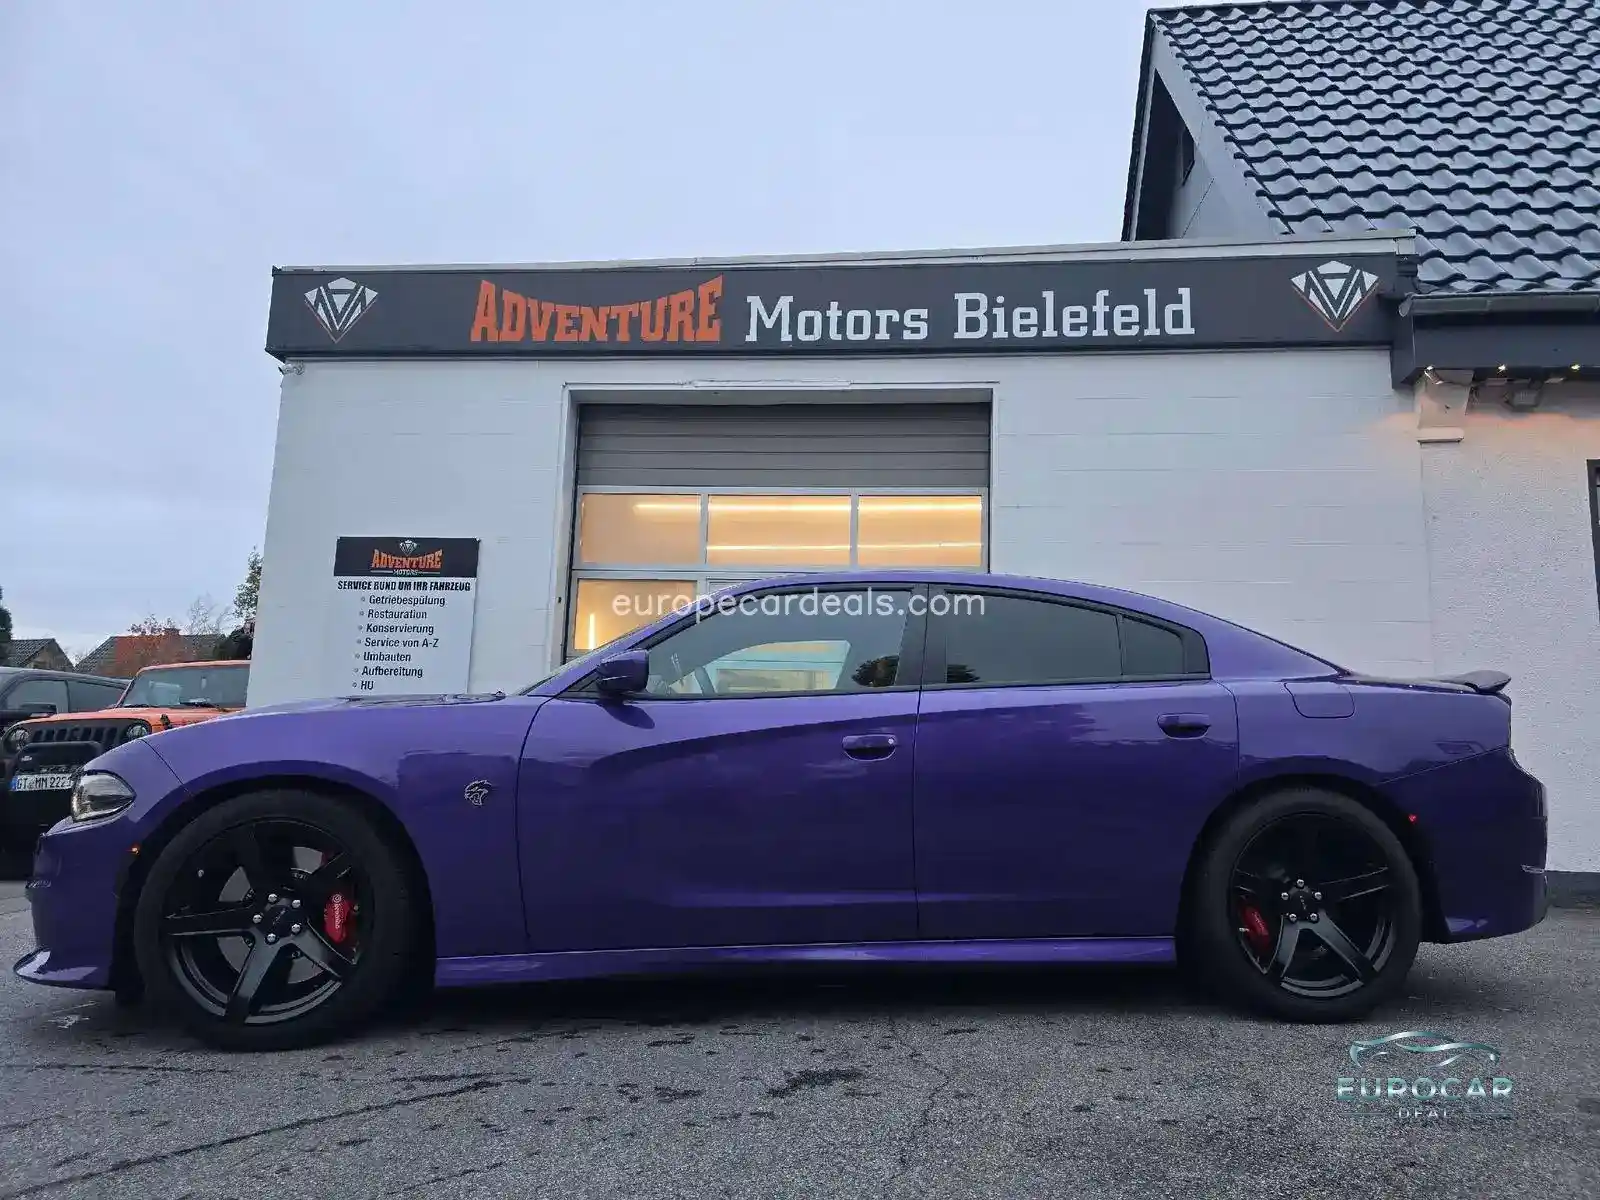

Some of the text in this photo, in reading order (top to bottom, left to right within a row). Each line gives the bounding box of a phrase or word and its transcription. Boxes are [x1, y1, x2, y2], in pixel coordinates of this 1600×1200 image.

[470, 275, 1195, 343] ADVENTURE Motors Bielefeld
[371, 548, 443, 569] ADVENTURE
[337, 580, 471, 592] SERVICE RUND UM IHR FAHRZEUG
[369, 595, 446, 607] Getriebespülung
[367, 609, 427, 619] Restauration
[366, 623, 434, 636] Konservierung
[364, 637, 439, 648] Service von A-Z
[363, 651, 412, 662] Umbauten
[361, 665, 424, 679] Aufbereitung
[360, 680, 374, 690] HU
